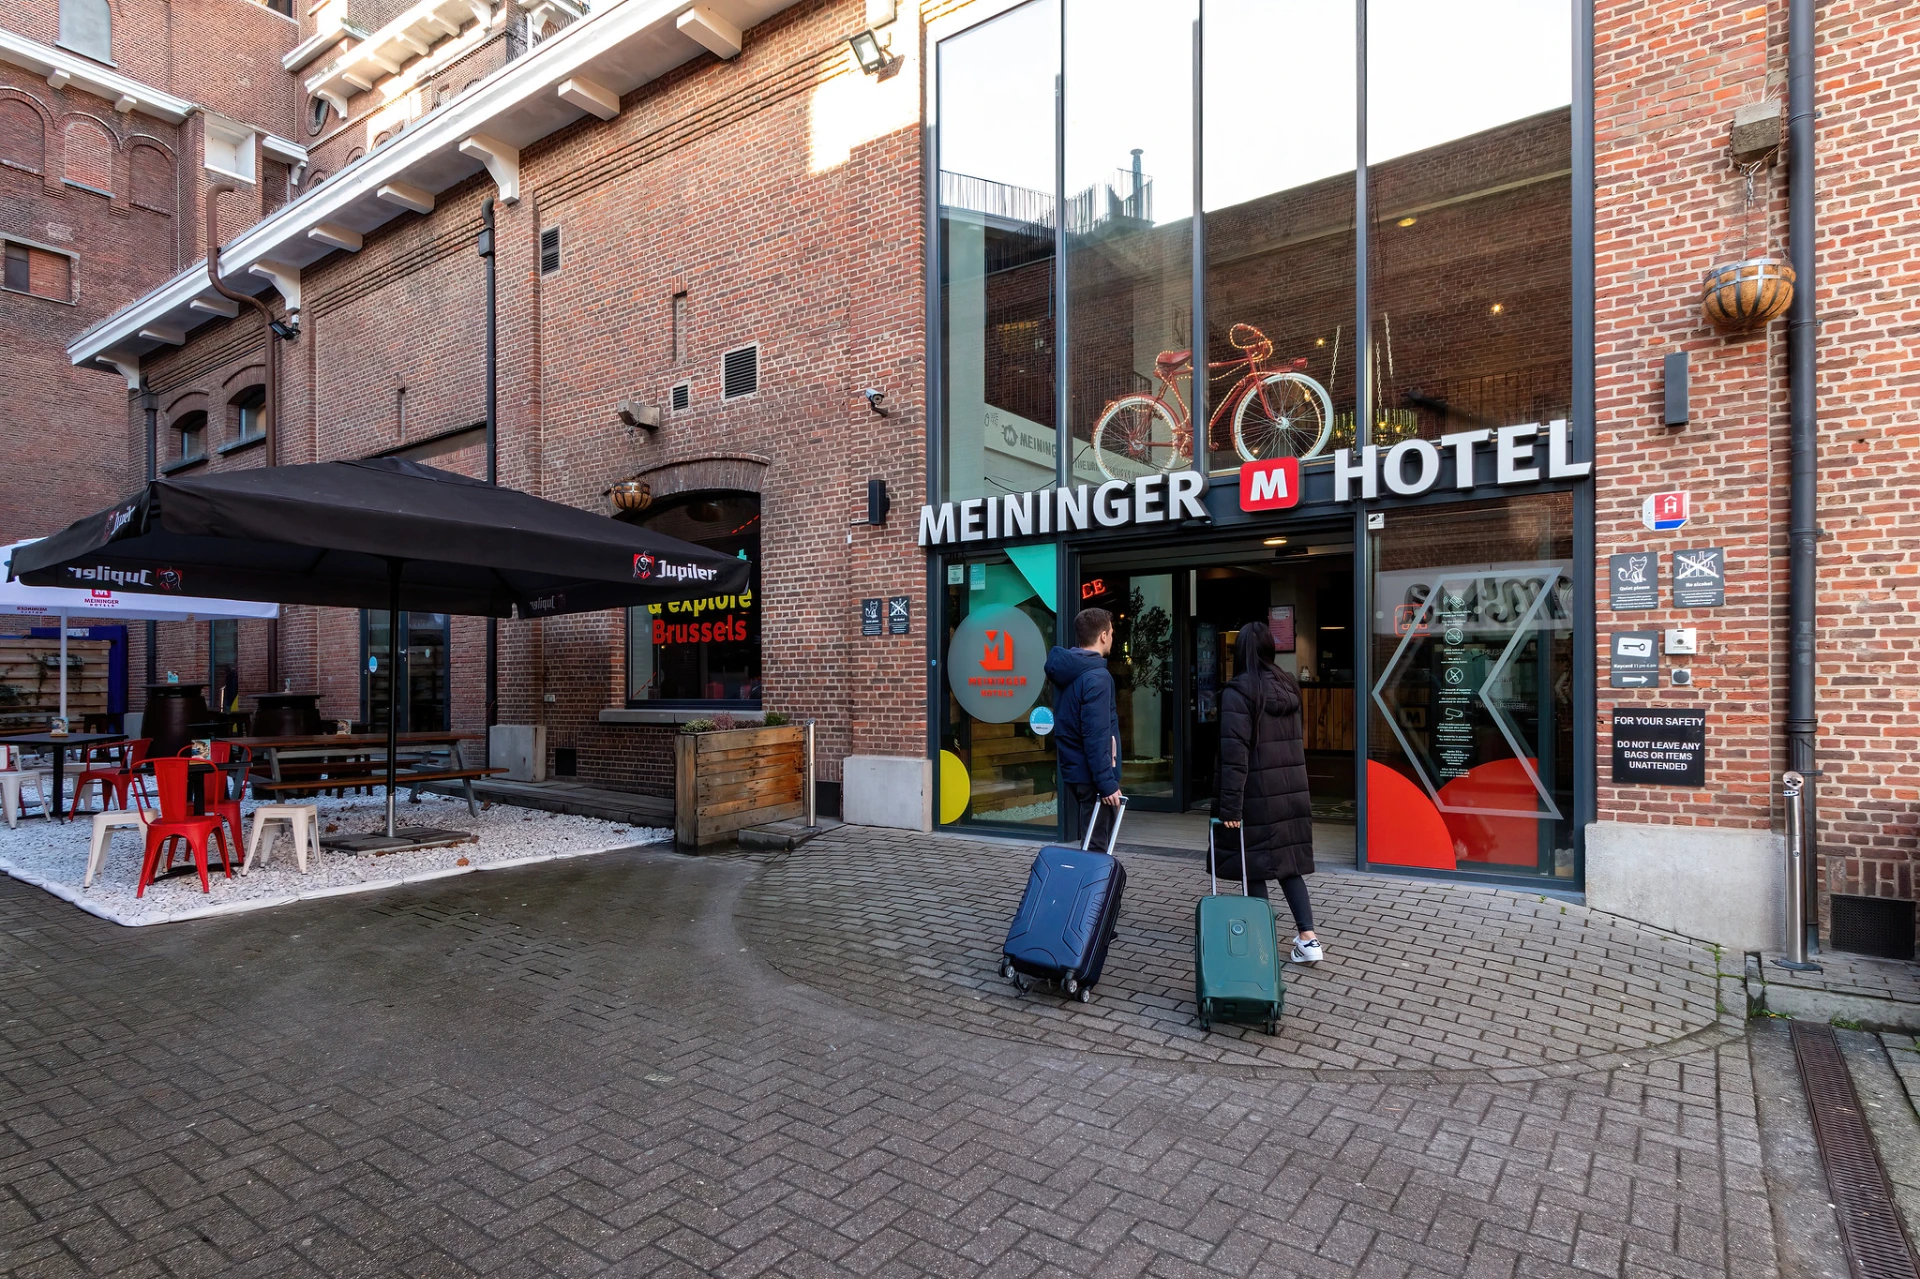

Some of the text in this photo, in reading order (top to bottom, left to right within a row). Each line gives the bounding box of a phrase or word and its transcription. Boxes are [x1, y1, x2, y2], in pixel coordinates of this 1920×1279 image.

[918, 419, 1593, 546] MEININGER M HOTEL
[656, 560, 718, 581] Jupiler
[652, 614, 747, 644] Brussels
[968, 676, 1027, 686] MEININGER
[980, 688, 1014, 697] HOTELS
[1614, 716, 1704, 726] FOR YOUR SAFETY
[1652, 742, 1680, 750] LEAVE
[1666, 752, 1692, 760] ITEMS
[1629, 761, 1687, 770] UNATTENDED
